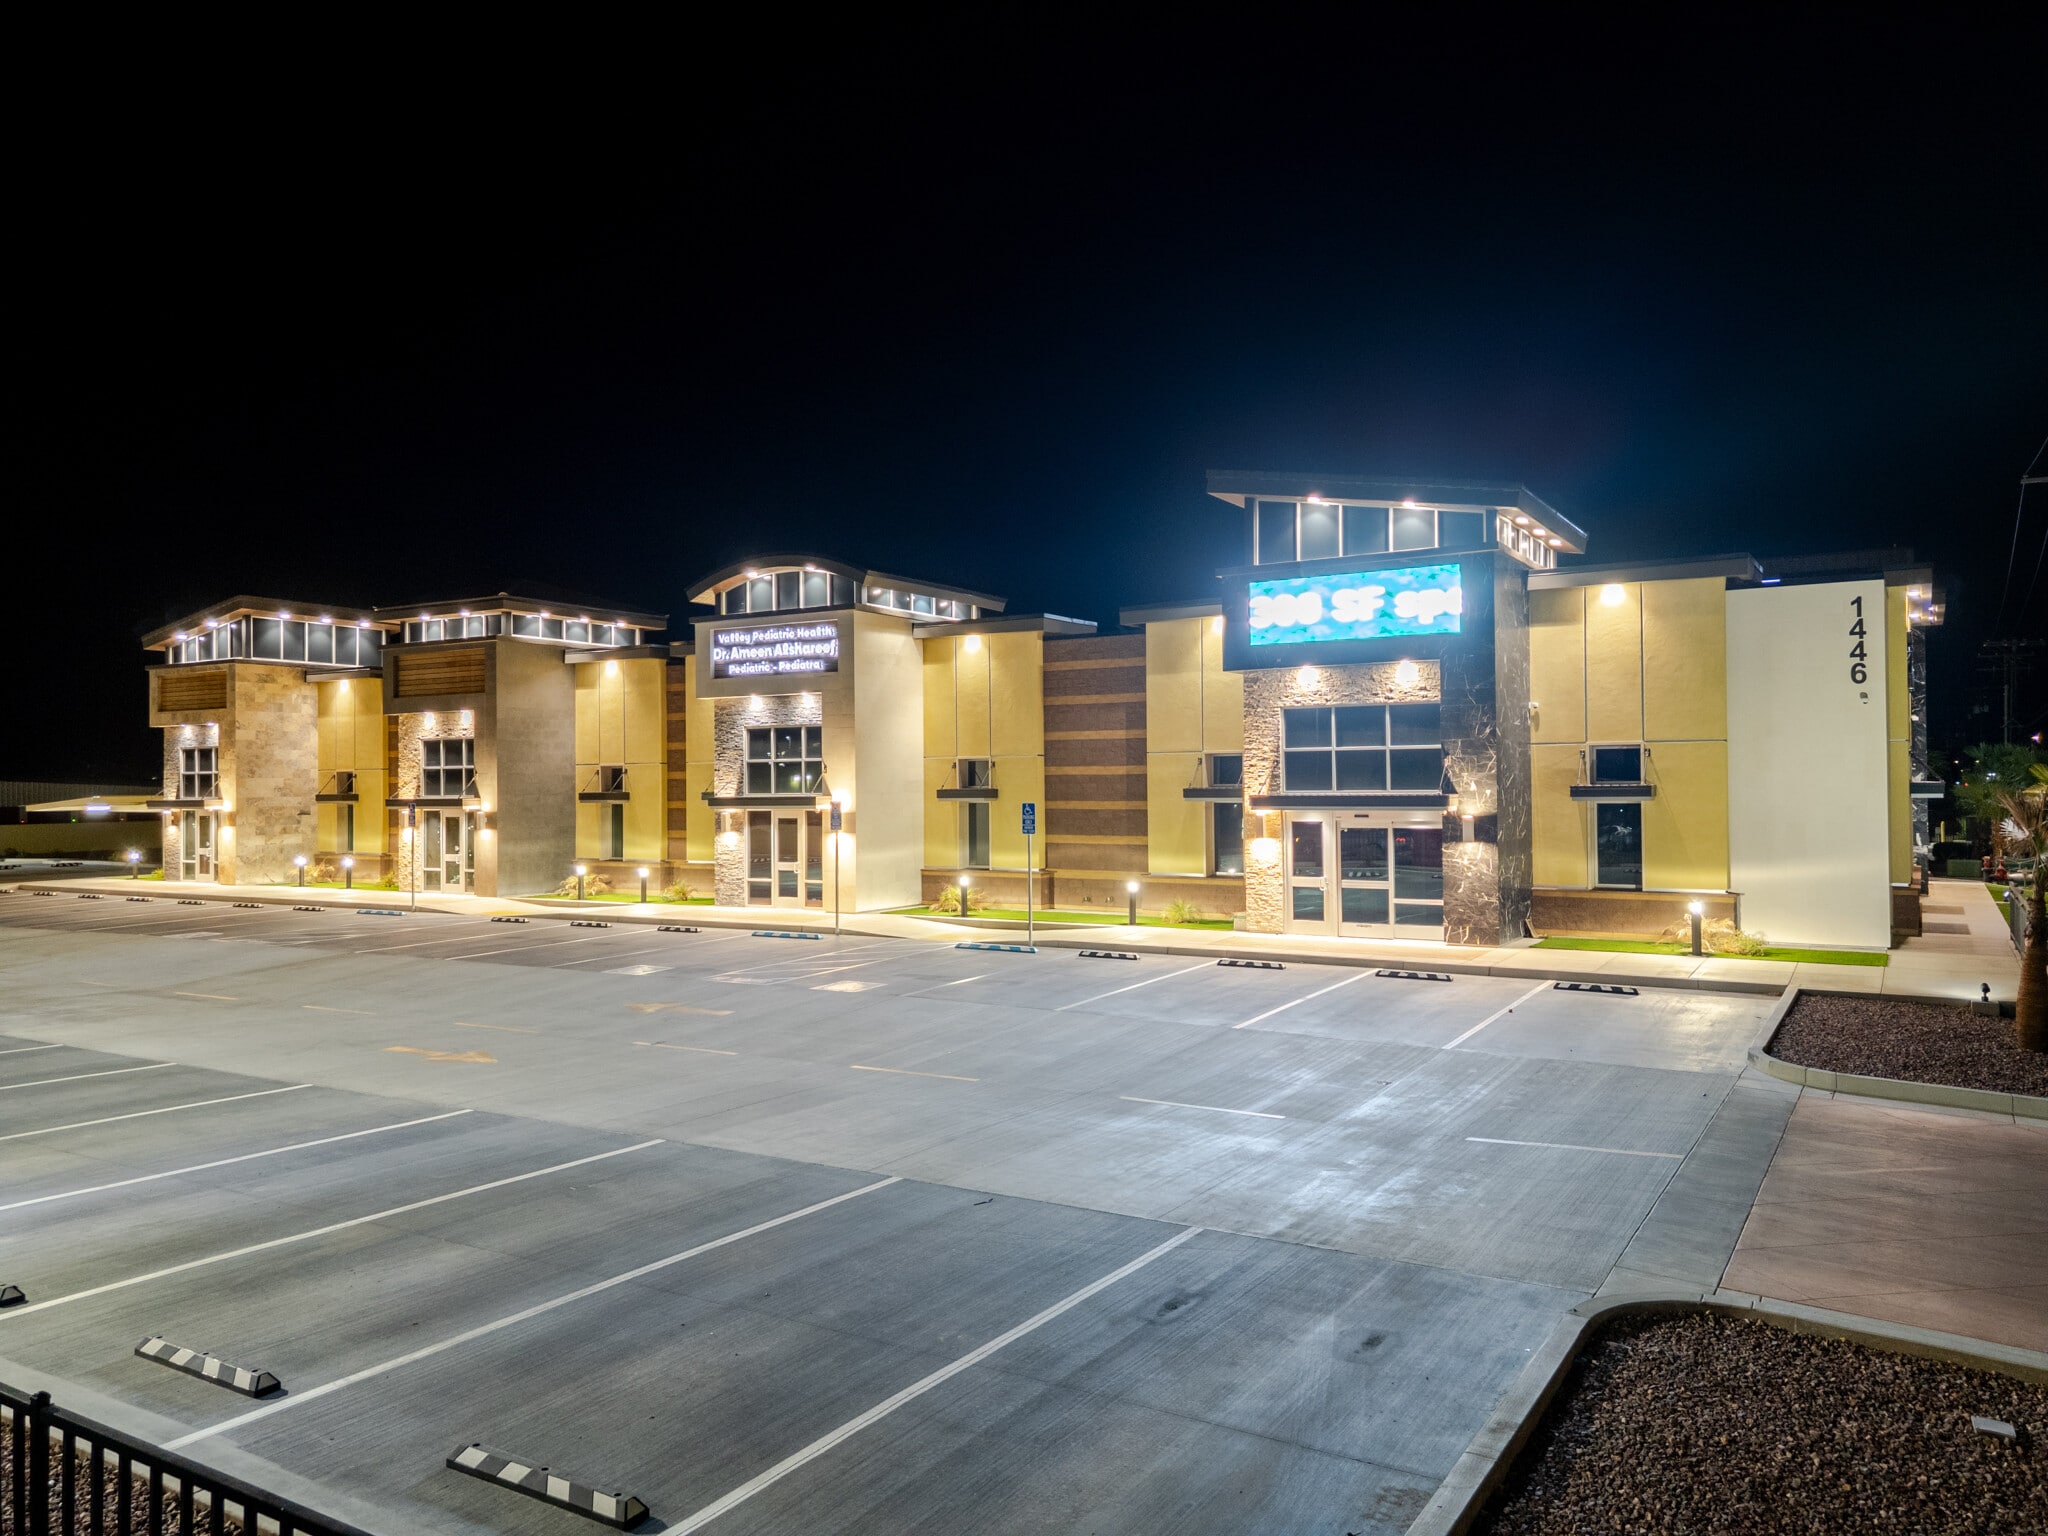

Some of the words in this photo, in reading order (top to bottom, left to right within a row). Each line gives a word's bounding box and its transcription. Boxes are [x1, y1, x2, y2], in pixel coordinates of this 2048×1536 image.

[717, 631, 751, 644] Valley
[752, 627, 795, 641] Pediatric
[797, 625, 834, 639] Health
[1849, 595, 1867, 684] 1446
[714, 647, 730, 661] Dr.
[730, 645, 773, 660] Ameen
[728, 660, 771, 675] Pediatric
